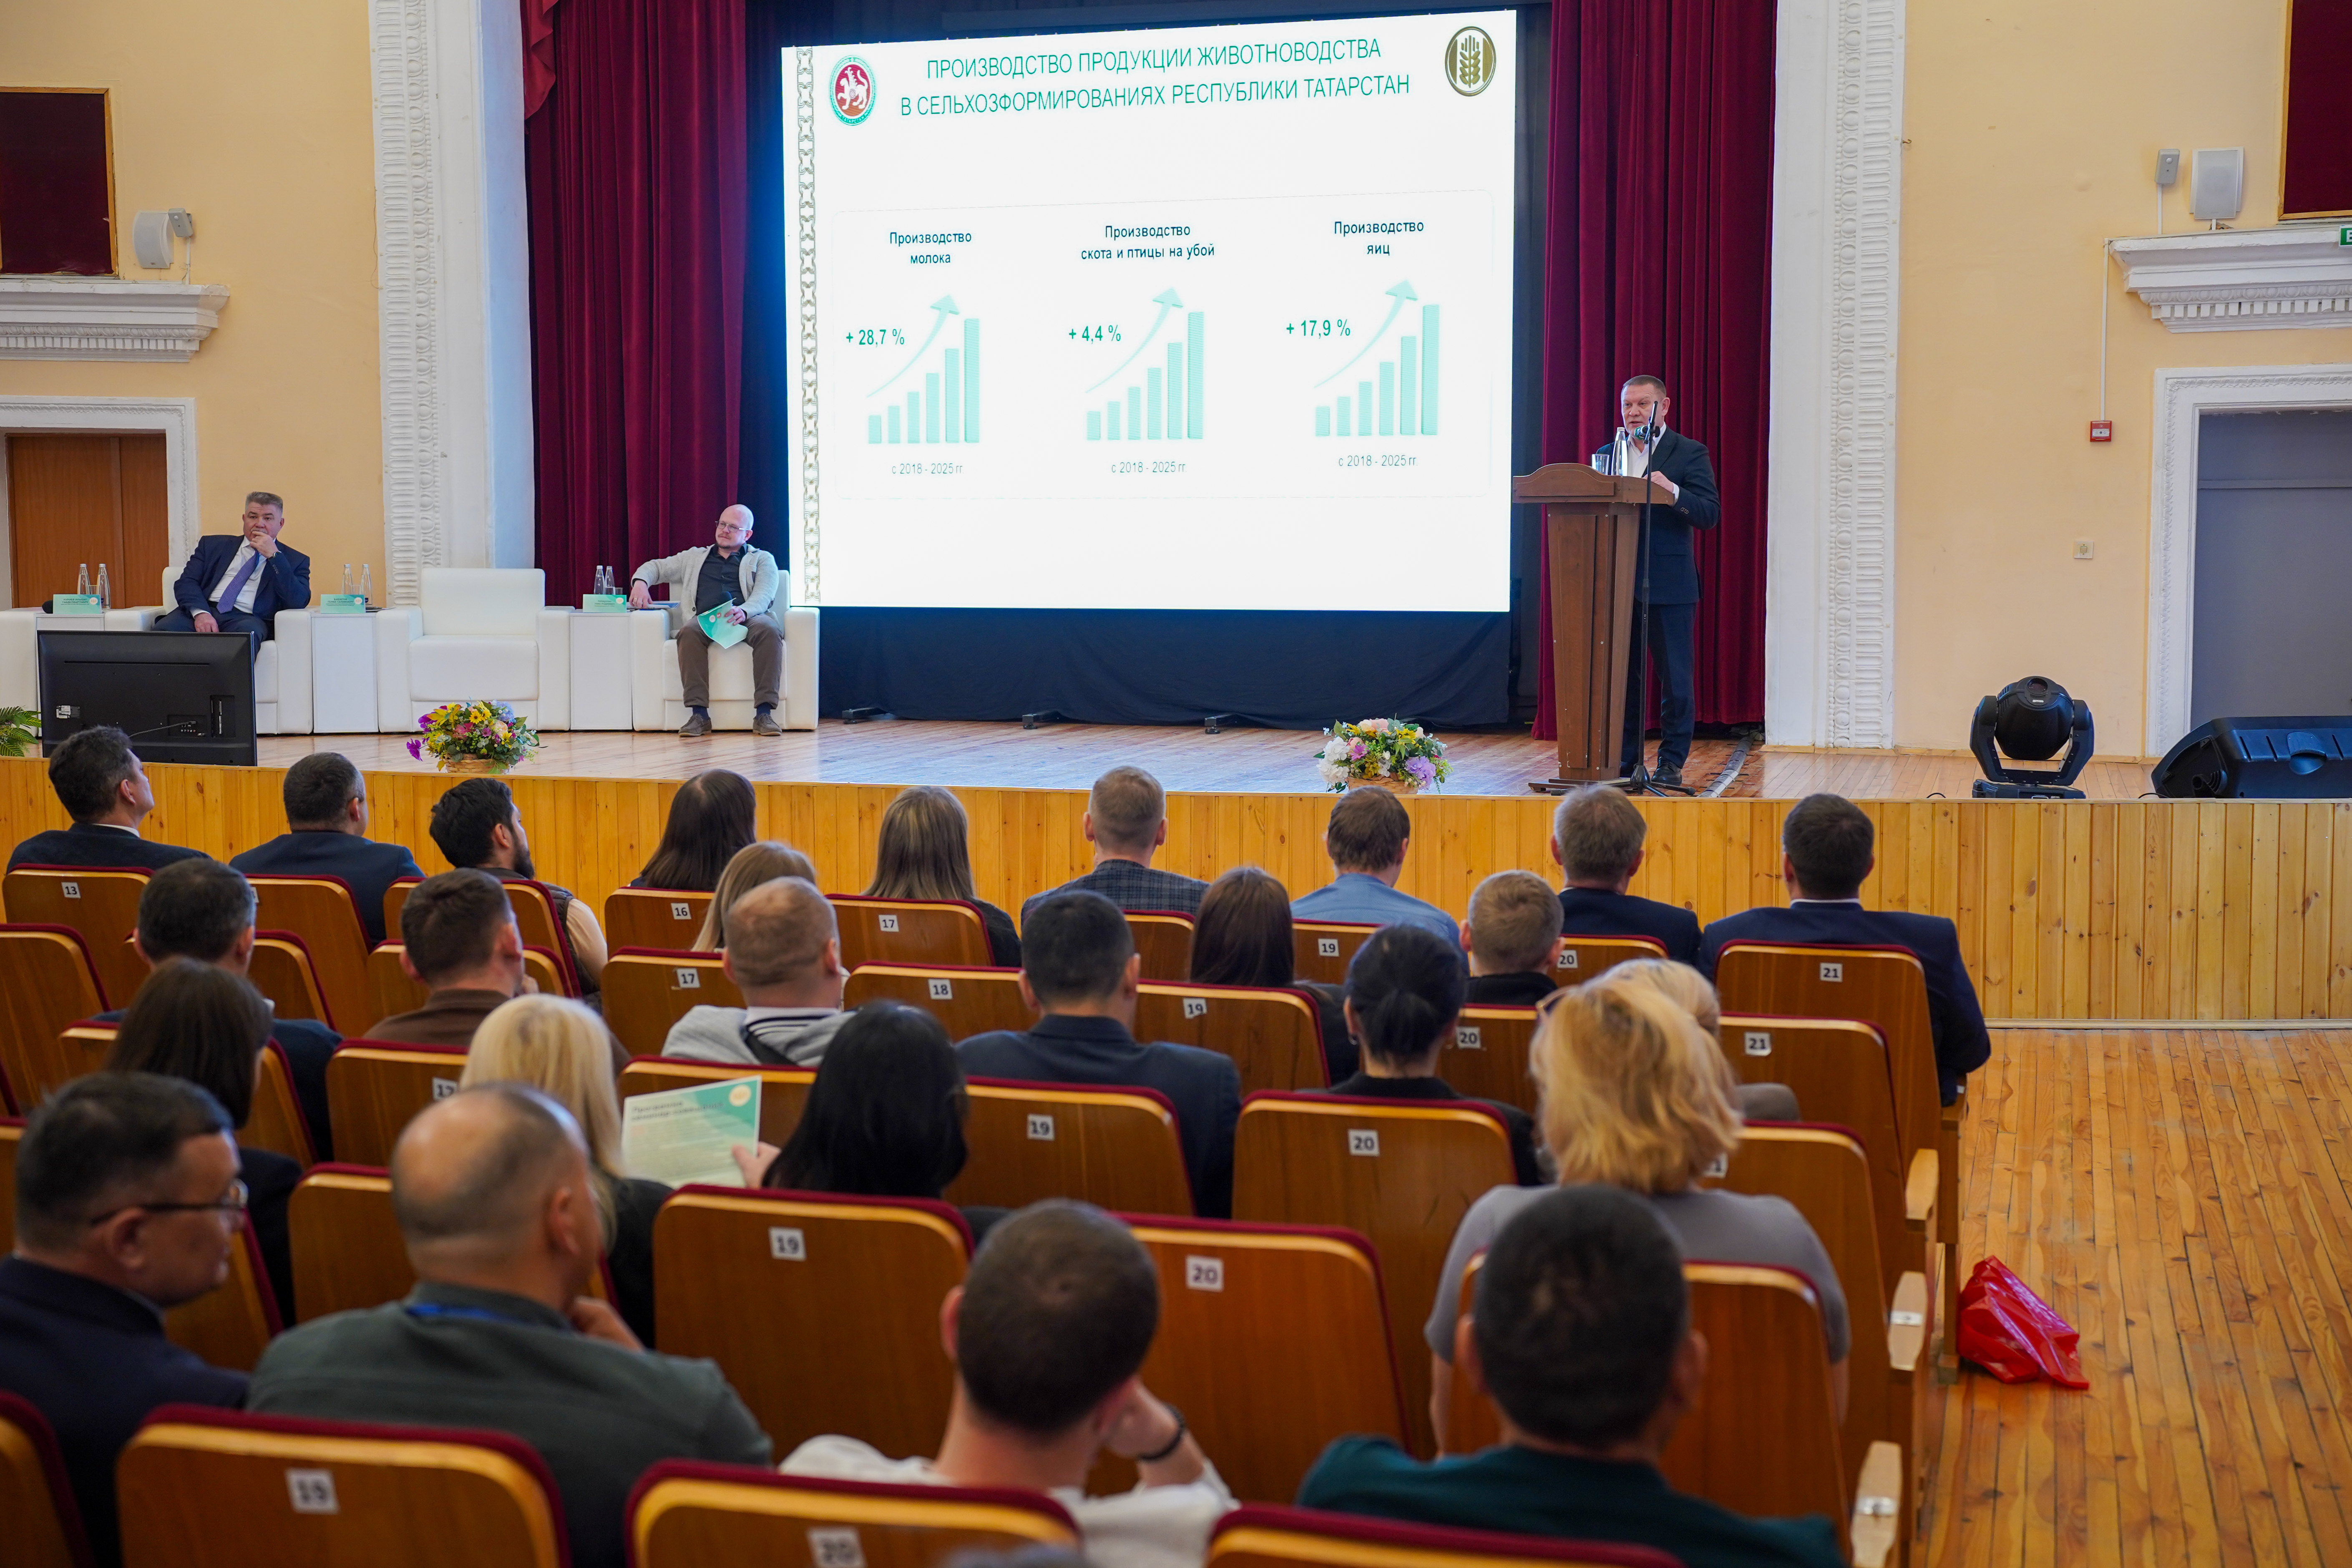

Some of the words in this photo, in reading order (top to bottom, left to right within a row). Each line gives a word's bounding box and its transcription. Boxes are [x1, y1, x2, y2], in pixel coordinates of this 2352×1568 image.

[928, 54, 1072, 79] ПРОИЗВОДСТВО
[1079, 48, 1191, 74] ПРОДУКЦИИ
[1197, 38, 1381, 66] ЖИВОТНОВОДСТВА
[901, 98, 911, 116] В
[917, 86, 1165, 115] СЕЛЬХОЗФОРМИРОВАНИЯХ
[1172, 80, 1297, 103] РЕСПУБЛИКИ
[1303, 74, 1409, 98] ТАТАРСТАН
[1105, 225, 1190, 241] Производство
[1334, 221, 1424, 237] Производство
[890, 232, 972, 247] Производство
[1081, 250, 1112, 259] скота
[1117, 250, 1123, 258] и
[1127, 248, 1164, 259] птицы
[1170, 248, 1182, 257] на
[1187, 243, 1214, 260] убой
[1367, 245, 1390, 256] яиц
[911, 254, 951, 264] молока
[1082, 325, 1103, 344] 4,4
[1108, 325, 1121, 342] %
[1301, 320, 1331, 339] 17,9
[1337, 319, 1351, 336] %
[859, 329, 887, 347] 28,7
[892, 329, 905, 345] %
[1347, 455, 1372, 466] 2018
[1381, 455, 1406, 466] 2025
[900, 463, 922, 474] 2018
[931, 463, 953, 474] 2025
[1120, 462, 1143, 473] 2018
[1152, 461, 1176, 473] 2025
[65, 886, 77, 895] 13
[675, 908, 687, 916] 16
[883, 919, 894, 928] 17
[1322, 944, 1335, 953] 19
[1560, 955, 1574, 964] 20
[681, 974, 695, 984] 17
[1824, 968, 1839, 978] 21
[934, 985, 948, 995] 18
[1188, 1004, 1203, 1014] 19
[1460, 1032, 1477, 1044] 20
[1749, 1038, 1766, 1050] 21
[1031, 1121, 1049, 1135] 19
[1354, 1136, 1374, 1150] 20
[777, 1236, 799, 1254] 19
[1194, 1265, 1218, 1283] 20
